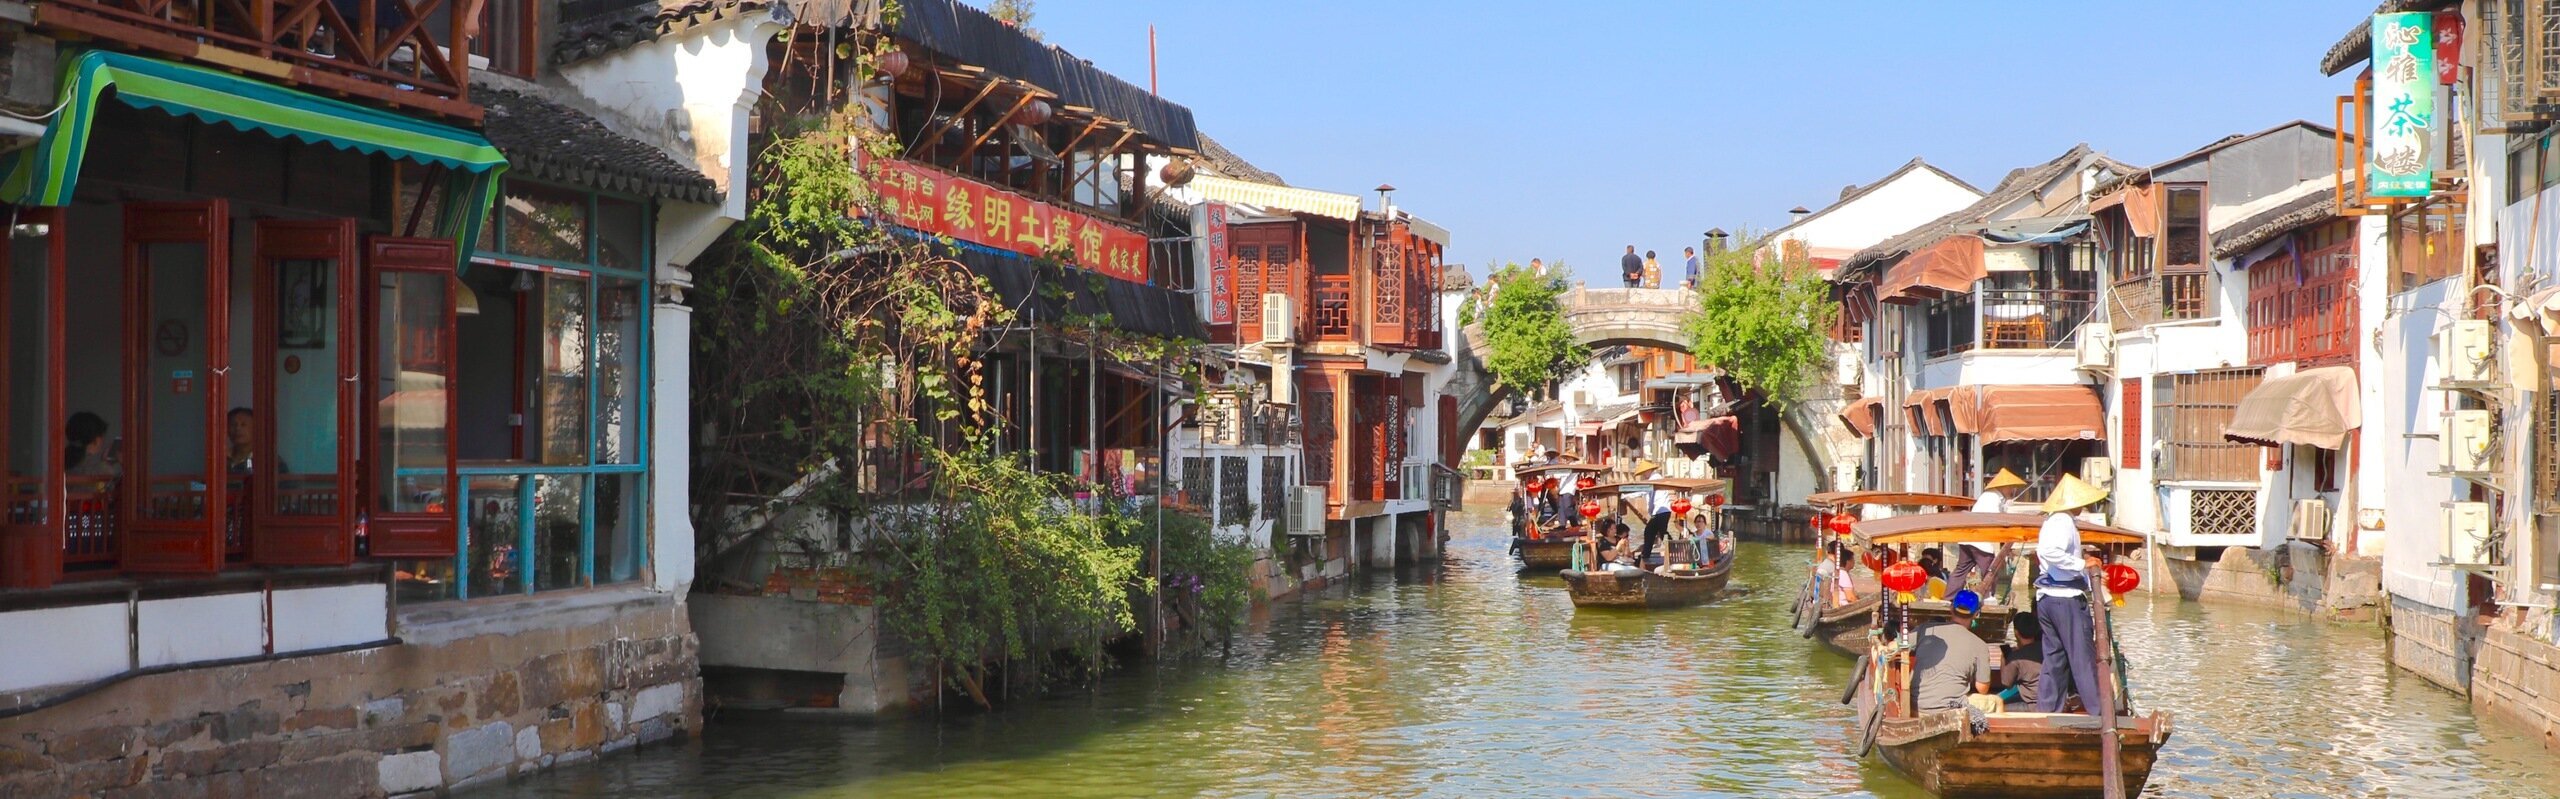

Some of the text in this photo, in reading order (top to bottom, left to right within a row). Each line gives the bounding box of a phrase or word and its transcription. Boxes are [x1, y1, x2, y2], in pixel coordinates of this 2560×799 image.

[943, 185, 1103, 265] 缘明土菜馆
[1109, 244, 1142, 277] 农家菜
[1211, 208, 1227, 318] 缘明土菜馆
